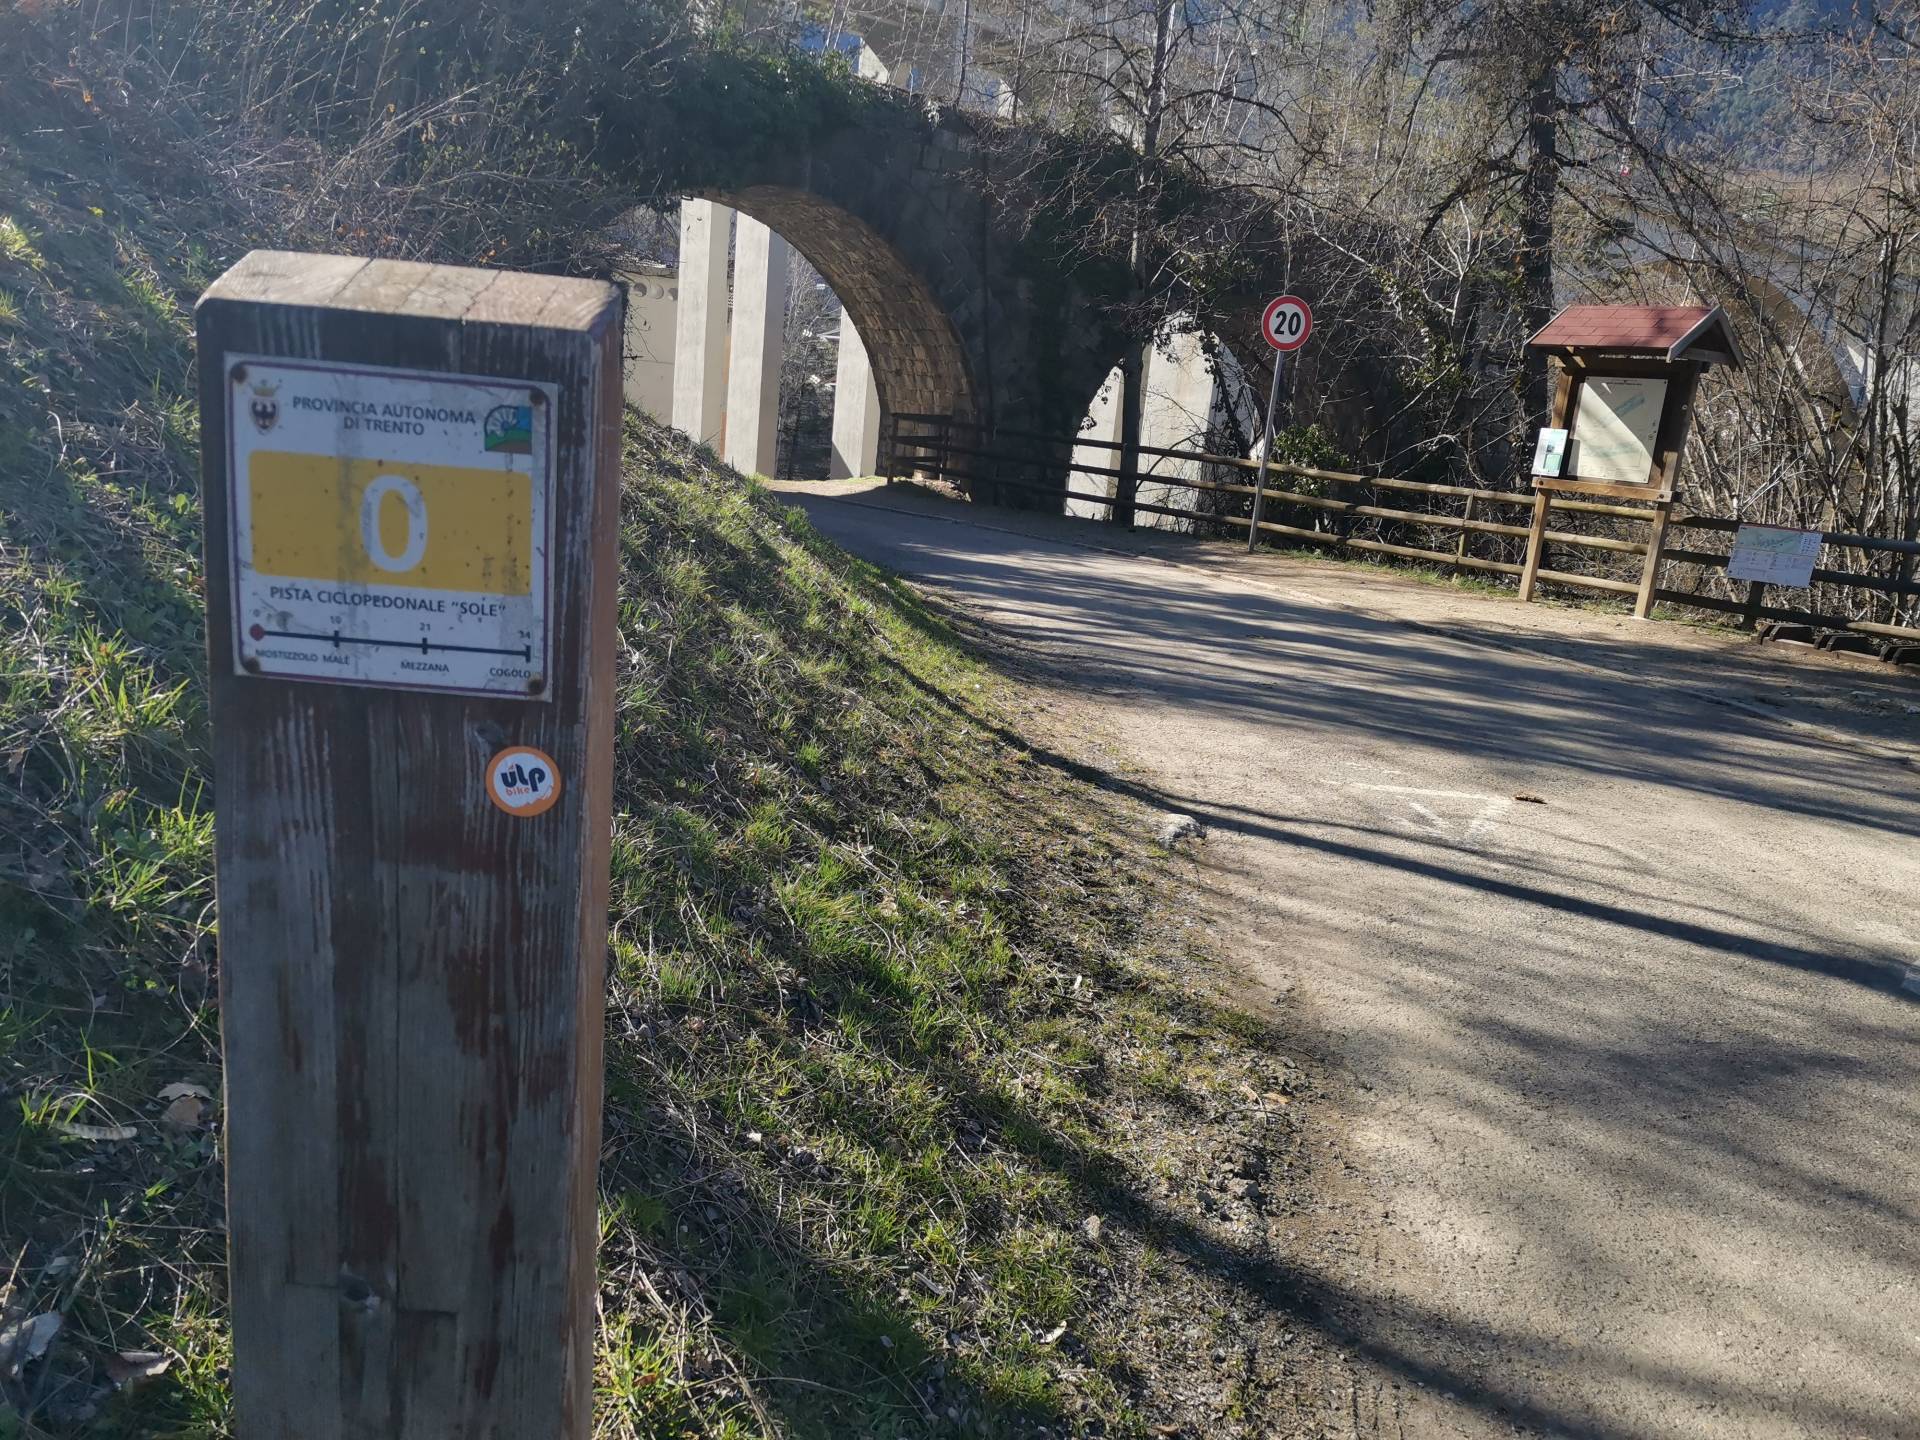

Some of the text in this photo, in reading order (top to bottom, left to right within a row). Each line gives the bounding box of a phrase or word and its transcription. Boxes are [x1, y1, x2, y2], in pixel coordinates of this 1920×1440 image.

[1274, 311, 1301, 336] 20
[292, 396, 477, 424] PROVINCIA AUTONOMA
[343, 416, 424, 436] DI TRENTO
[360, 474, 428, 573] 0
[270, 586, 313, 601] PISTA
[317, 591, 445, 613] CICLOPEDONALE
[420, 622, 431, 632] 21
[400, 661, 450, 673] MEZZANA
[489, 667, 531, 679] COGOLO
[505, 786, 530, 797] bike
